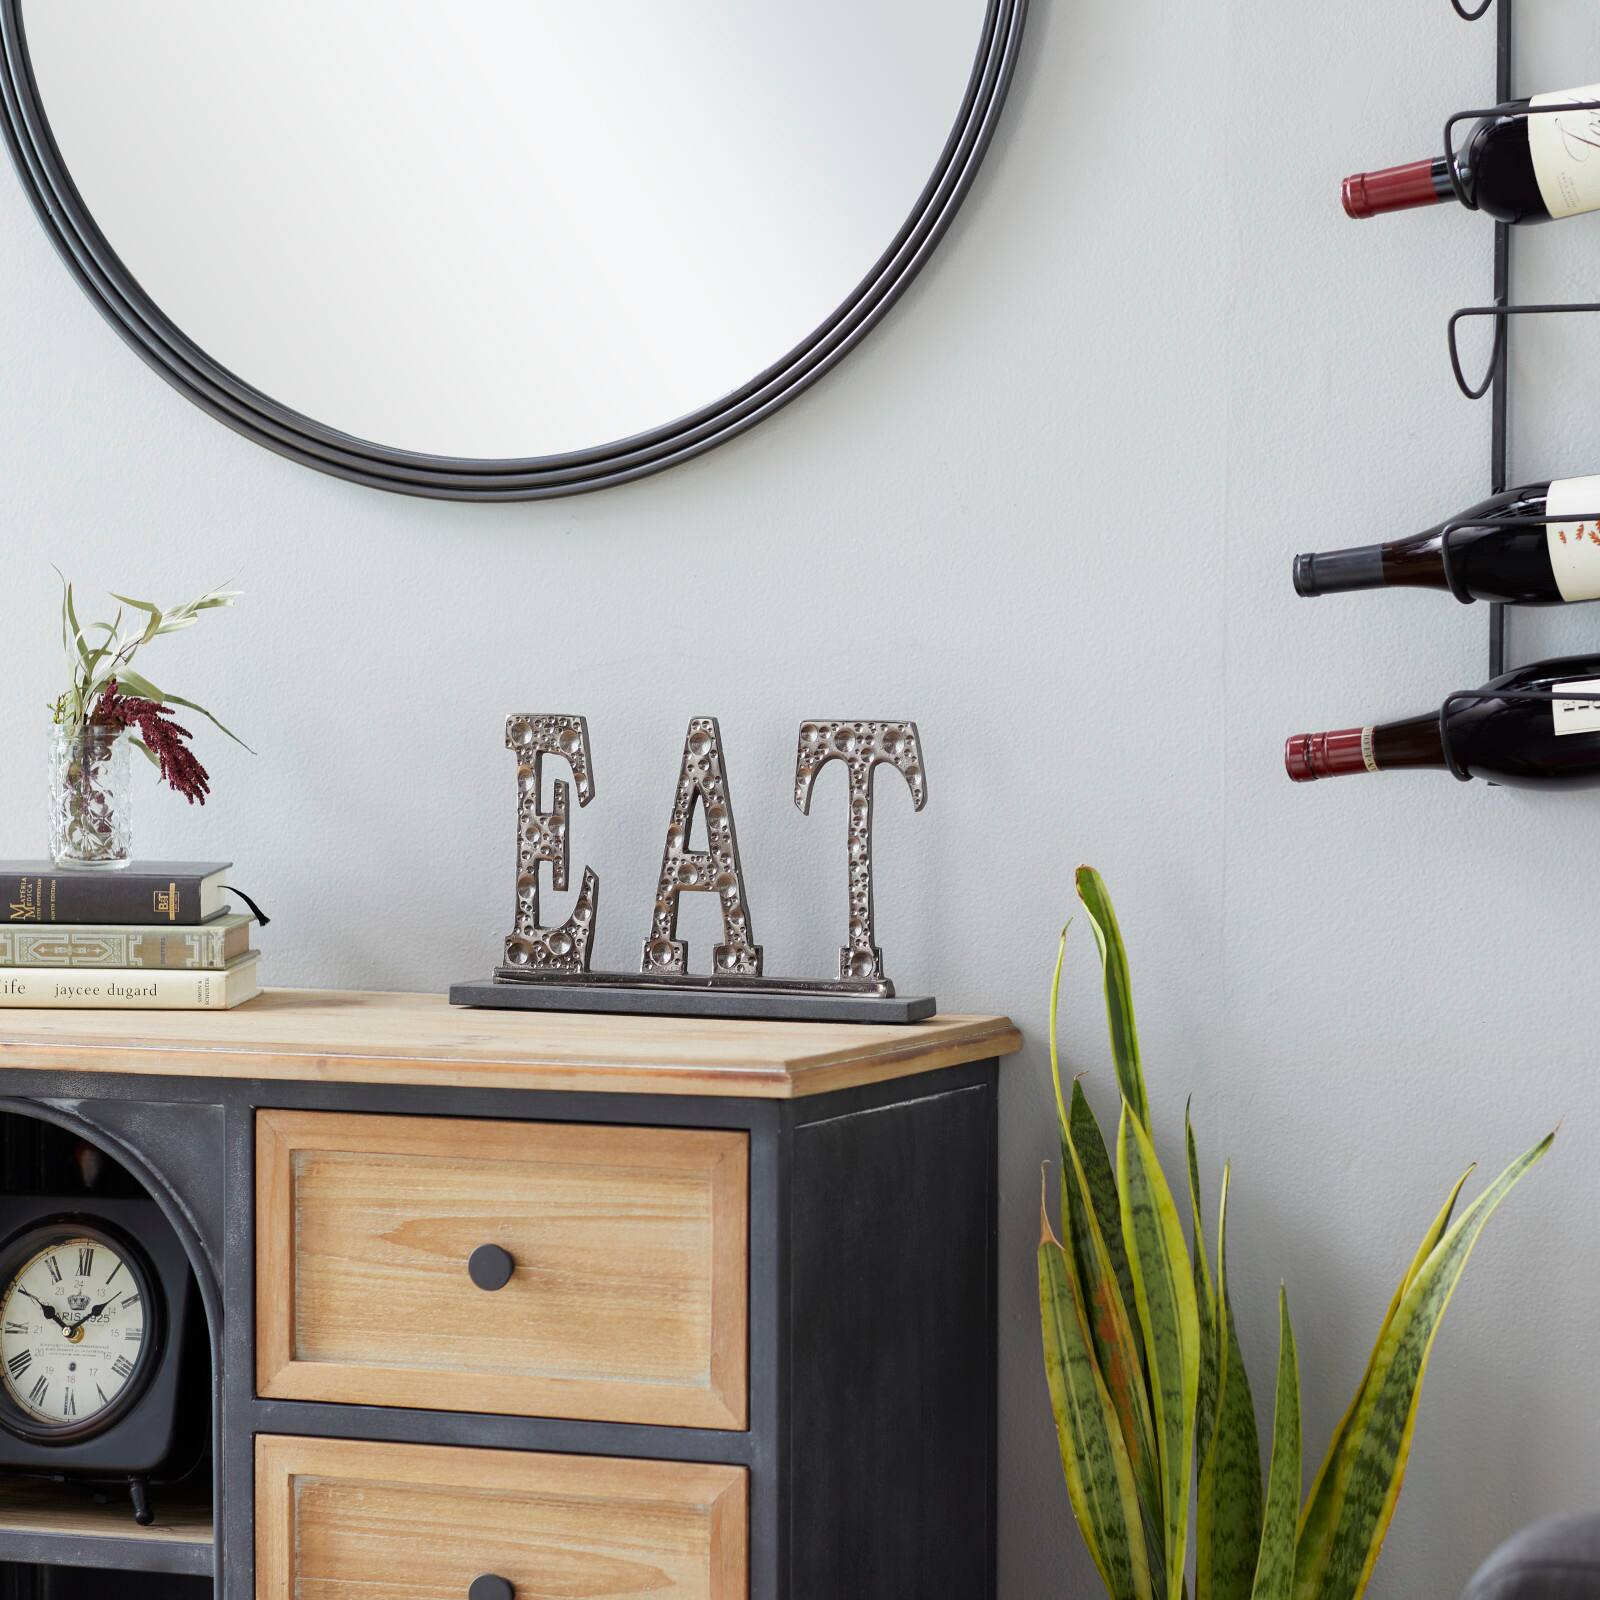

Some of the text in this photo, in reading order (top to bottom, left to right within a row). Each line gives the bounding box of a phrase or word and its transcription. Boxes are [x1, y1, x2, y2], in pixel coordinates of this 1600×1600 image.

[504, 714, 927, 980] EAT
[10, 877, 28, 920] MATERIA
[24, 883, 36, 918] MEDICA
[0, 978, 26, 994] ife
[54, 983, 158, 999] jaycee dugard
[55, 1286, 65, 1296] 23
[97, 1288, 106, 1297] 13
[50, 1311, 110, 1324] ARIS 925
[33, 1325, 43, 1334] 21
[111, 1328, 120, 1337] 15
[45, 1366, 55, 1375] 19
[89, 1367, 98, 1377] 17
[67, 1375, 76, 1384] 18
